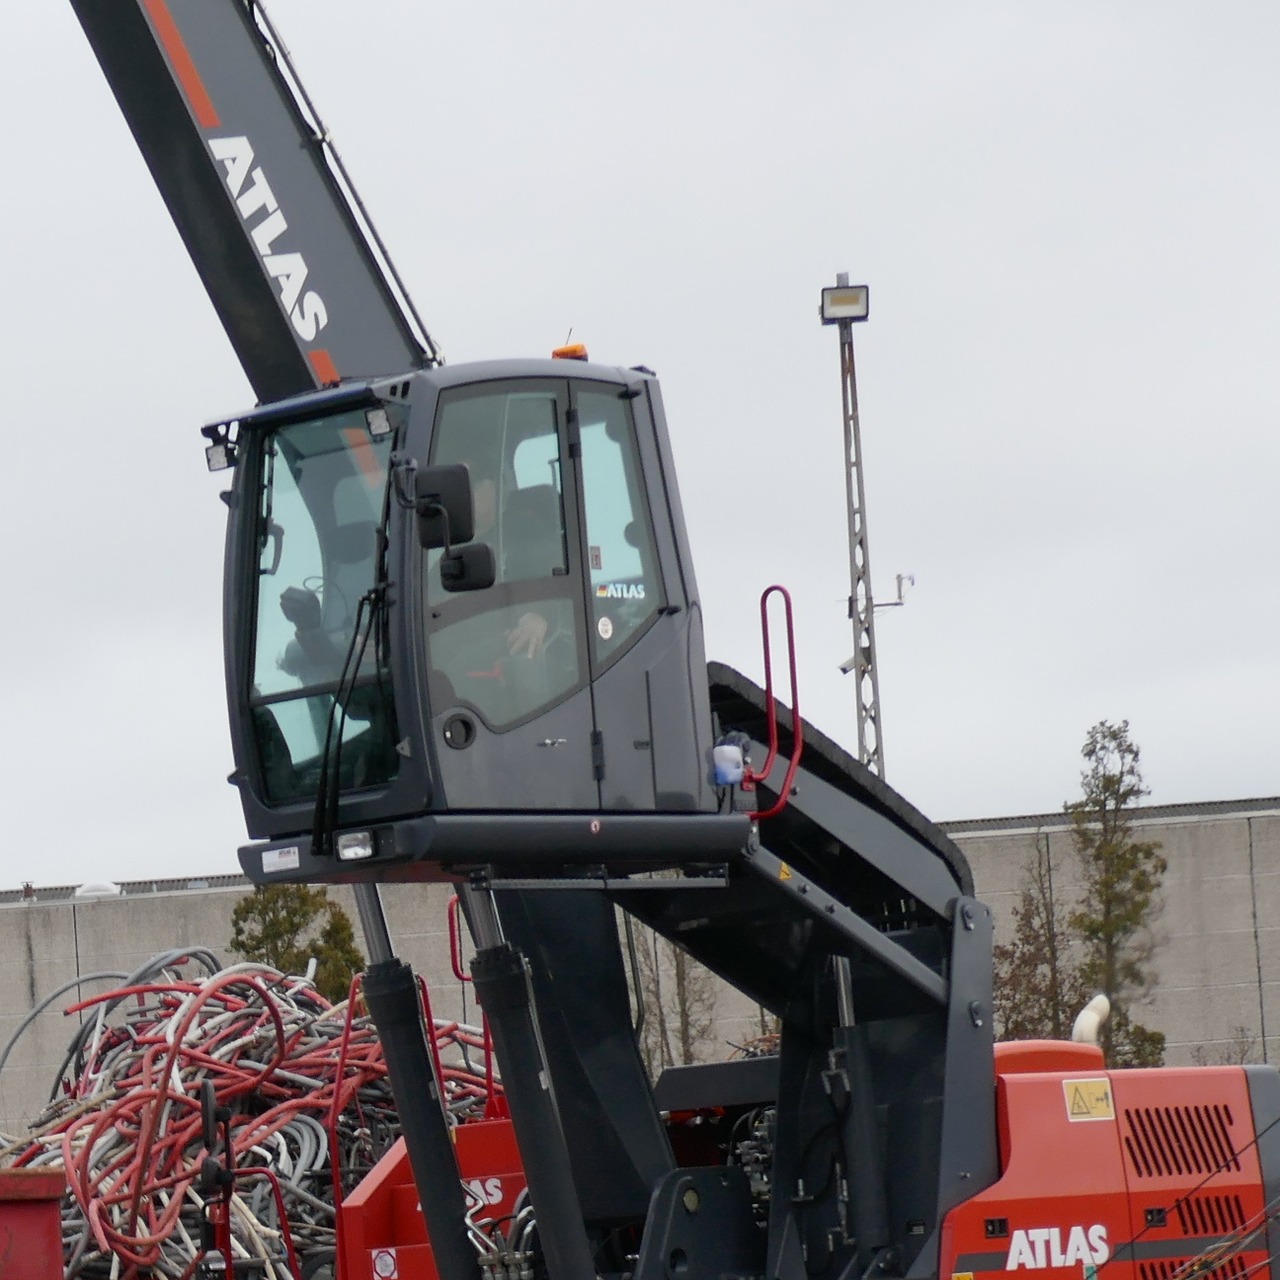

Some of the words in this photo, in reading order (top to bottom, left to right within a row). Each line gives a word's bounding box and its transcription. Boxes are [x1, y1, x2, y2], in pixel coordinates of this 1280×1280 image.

[207, 135, 328, 342] ATLAS
[607, 584, 646, 599] ATLAS
[1005, 1224, 1110, 1272] ATLAS
